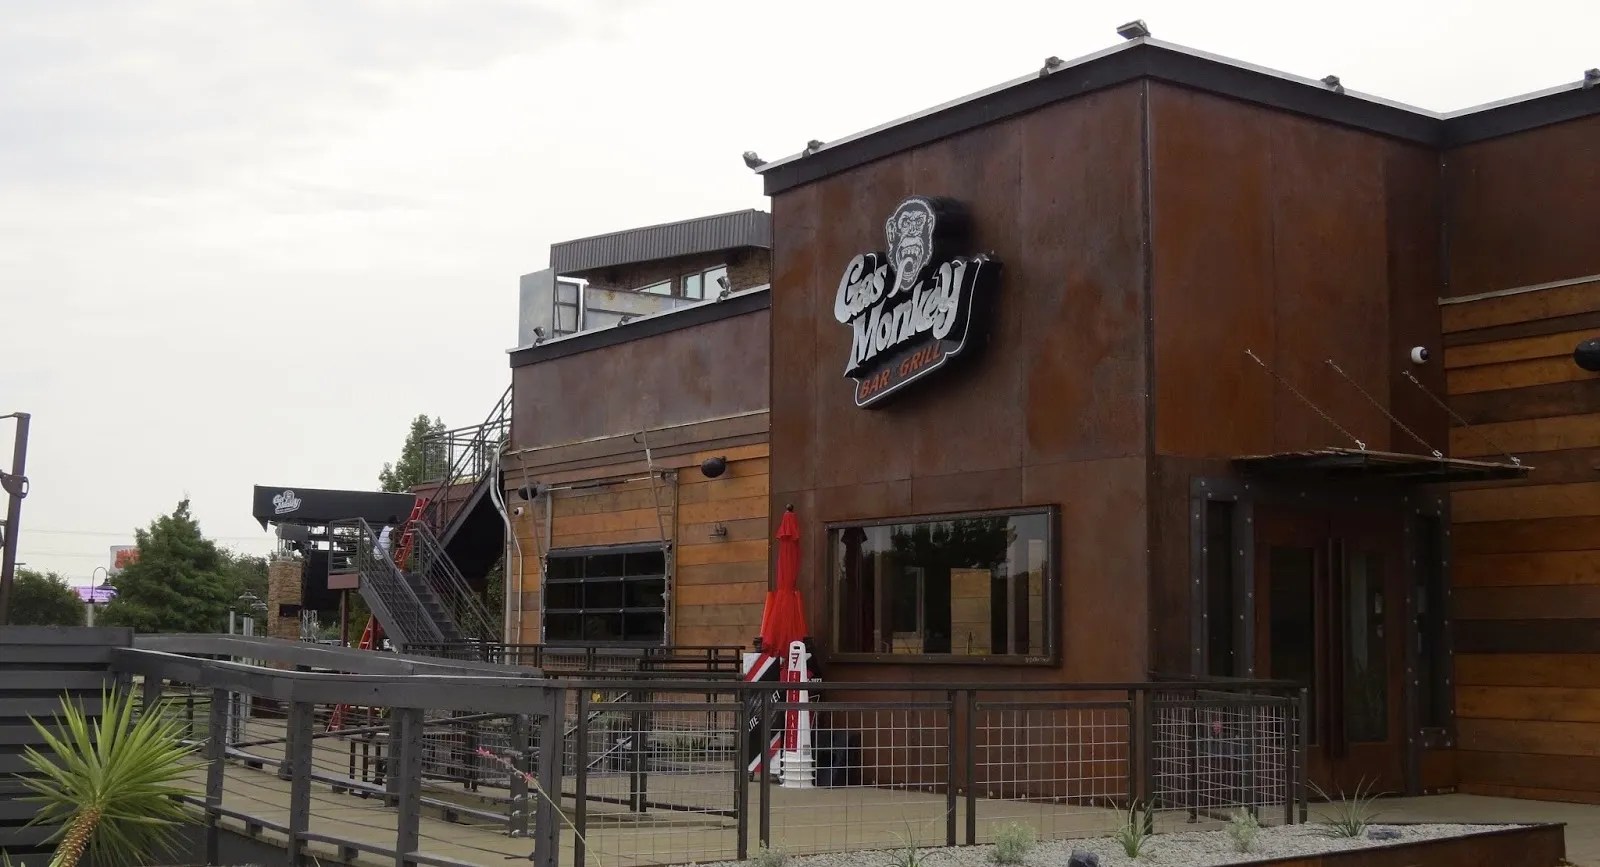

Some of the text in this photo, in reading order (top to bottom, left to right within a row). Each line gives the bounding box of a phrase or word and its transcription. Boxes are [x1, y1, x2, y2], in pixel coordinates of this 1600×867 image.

[834, 254, 888, 323] Gas
[844, 261, 967, 377] Monkey
[860, 341, 941, 399] BAR GRILL
